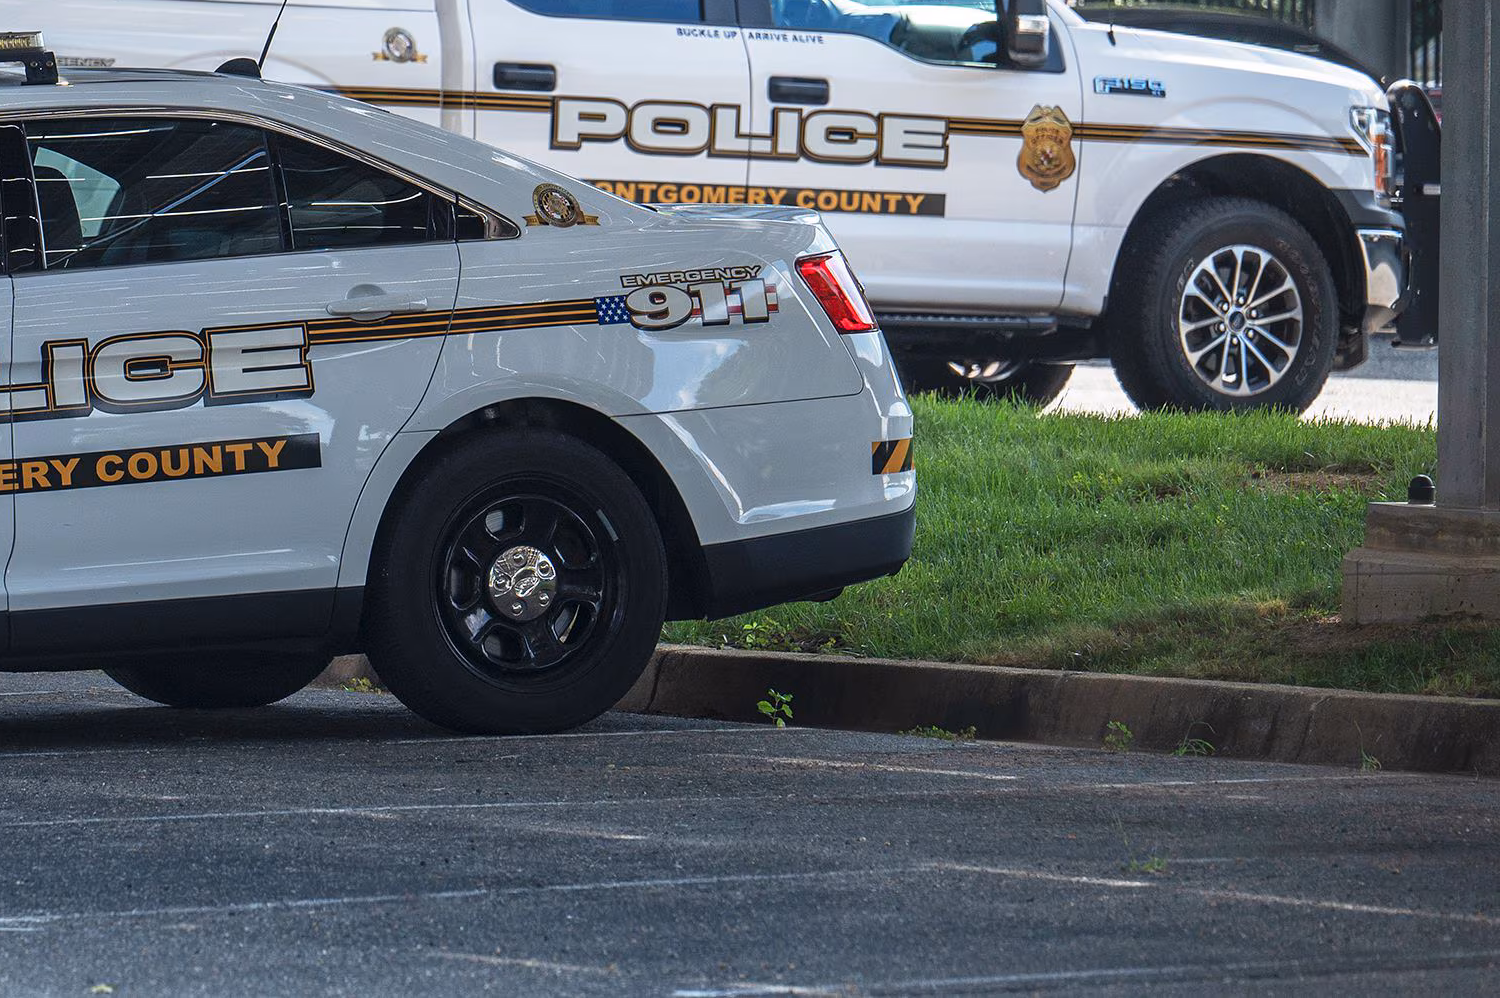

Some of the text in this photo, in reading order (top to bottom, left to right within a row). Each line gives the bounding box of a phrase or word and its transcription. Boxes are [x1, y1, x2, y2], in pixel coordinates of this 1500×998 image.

[676, 27, 825, 45] BUCKLE UP ARRIVE ALIVE
[549, 95, 950, 168] POLICE
[594, 180, 925, 215] ONTGOMERY COUNTY
[619, 264, 762, 288] EMERGENCY
[625, 278, 770, 332] 911
[95, 439, 288, 482] COUNTY
